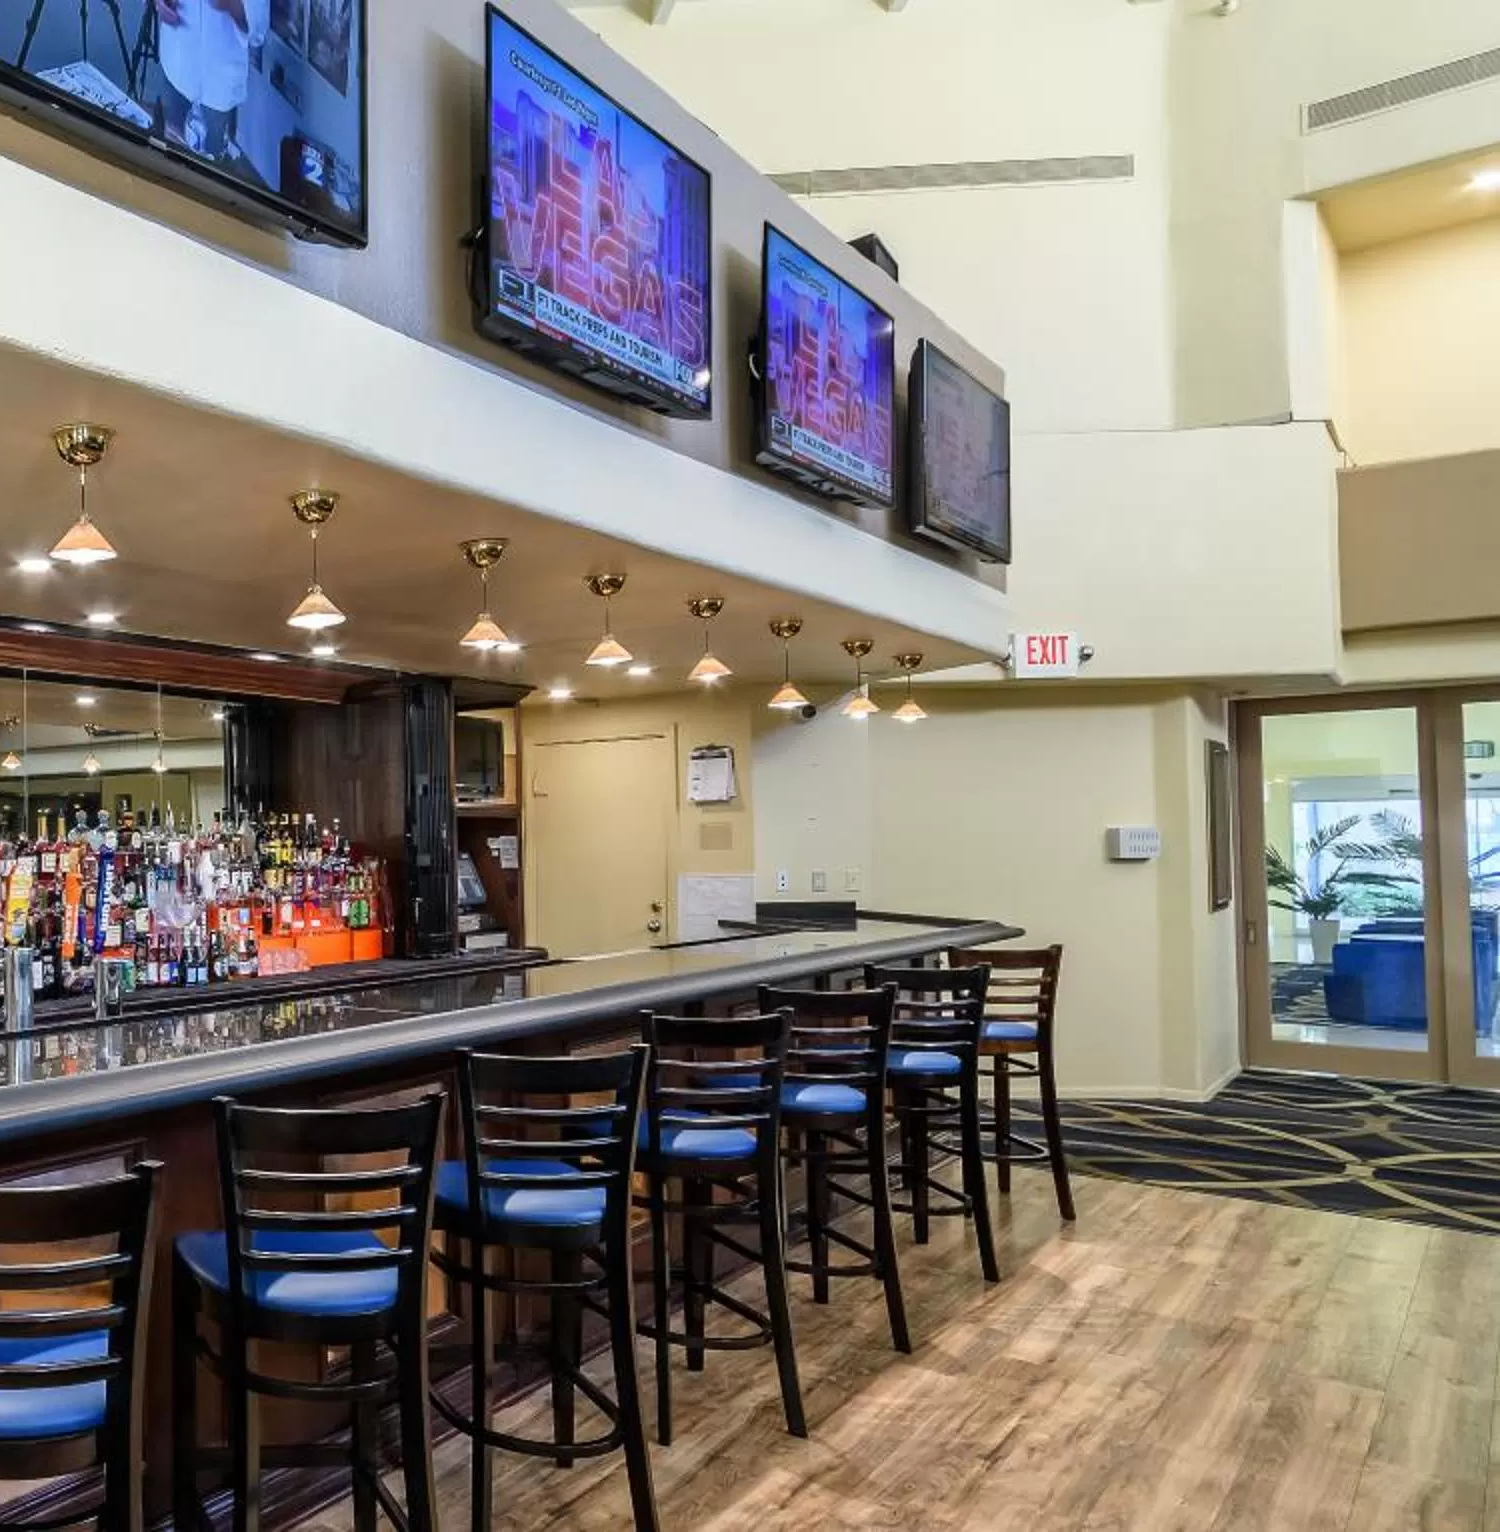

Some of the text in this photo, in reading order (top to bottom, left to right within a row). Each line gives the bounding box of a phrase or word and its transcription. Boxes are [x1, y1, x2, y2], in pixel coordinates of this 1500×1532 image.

[495, 164, 705, 370] VEGAS
[550, 297, 580, 324] TRACK
[609, 327, 626, 348] AND
[1027, 635, 1069, 665] EXIT
